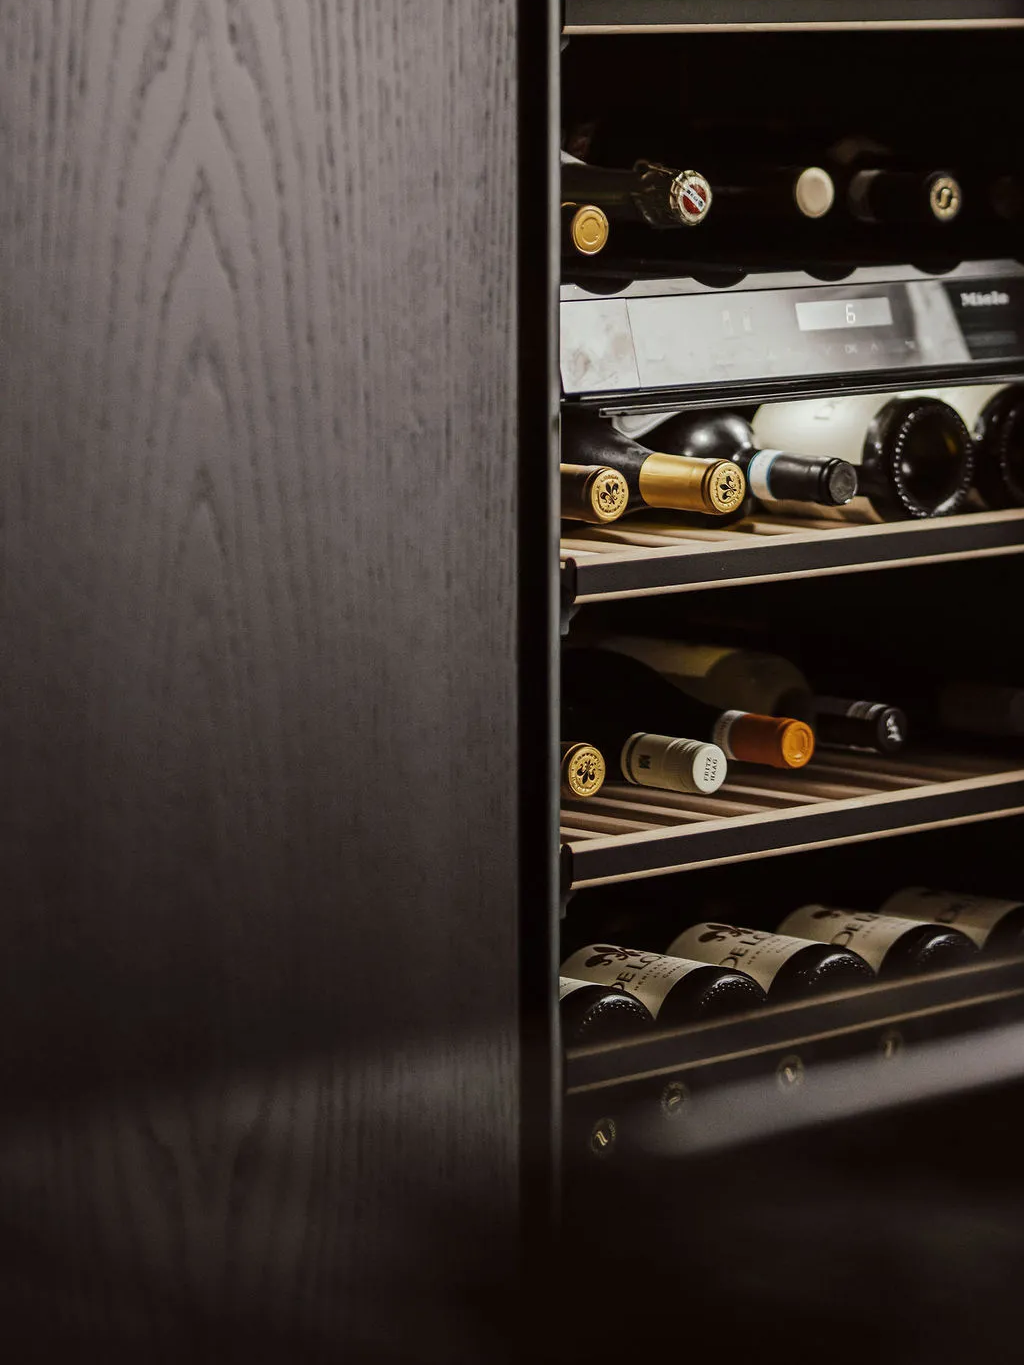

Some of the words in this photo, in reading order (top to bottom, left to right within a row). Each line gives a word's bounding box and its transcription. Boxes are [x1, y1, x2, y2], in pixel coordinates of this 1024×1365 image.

[960, 291, 1009, 306] Miele
[845, 303, 856, 324] 6
[703, 756, 712, 782] FRITZ
[710, 758, 718, 782] HAAG
